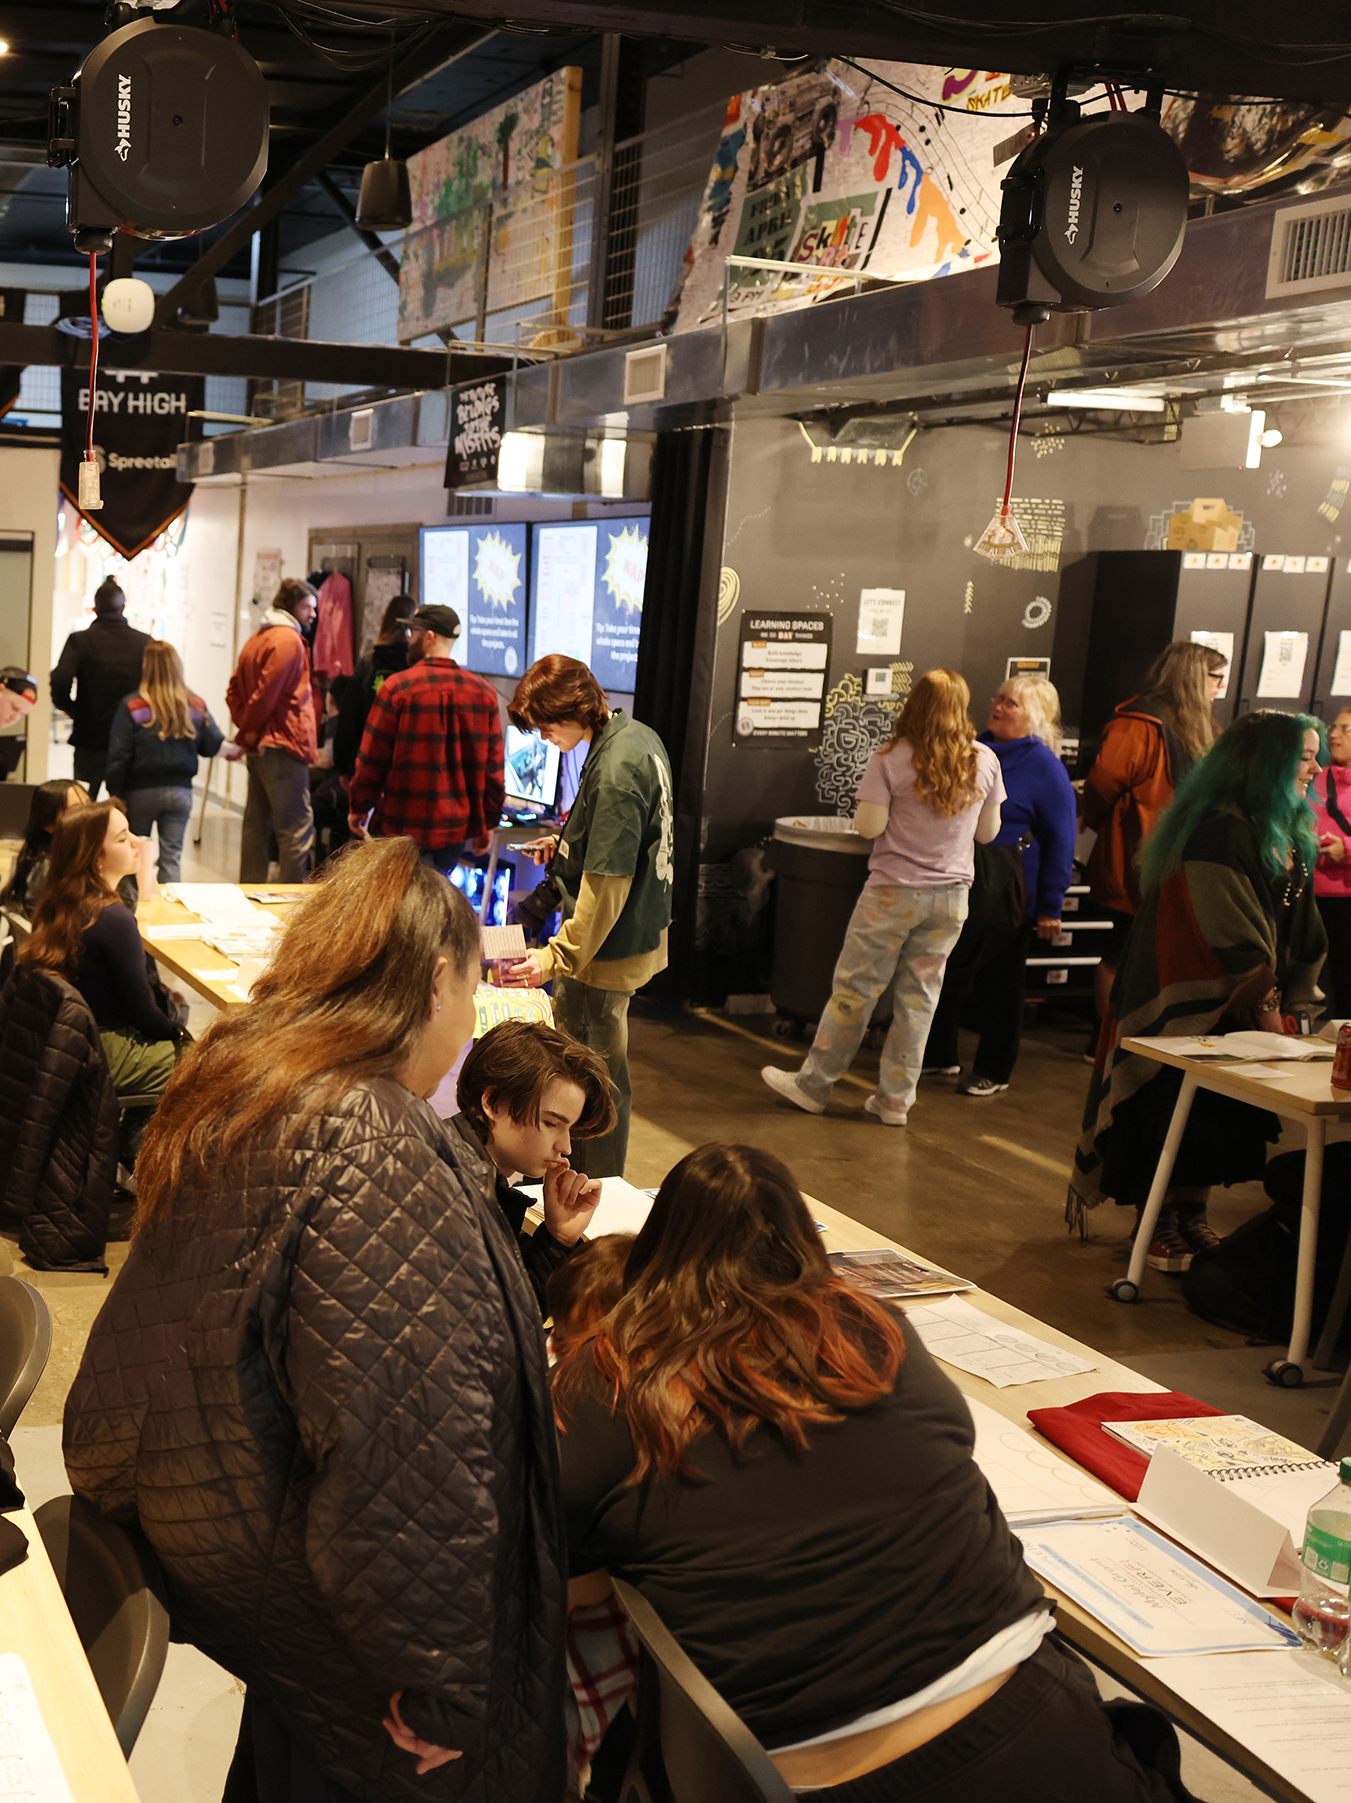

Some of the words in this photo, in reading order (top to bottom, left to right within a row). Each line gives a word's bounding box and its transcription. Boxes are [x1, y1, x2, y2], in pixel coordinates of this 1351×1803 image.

[117, 73, 131, 138] HUSKY
[1067, 165, 1084, 223] HUSKY
[78, 388, 125, 413] BAY
[127, 391, 187, 415] HIGH
[605, 623, 616, 633] Take
[617, 625, 628, 636] your
[628, 624, 640, 635] time
[750, 619, 791, 630] LEARNING
[792, 620, 825, 631] SPACES
[778, 631, 794, 640] BAY
[596, 636, 611, 646] whole
[611, 638, 625, 649] space
[610, 650, 620, 660] the
[620, 651, 638, 663] project
[1119, 1560, 1188, 1605] EVERFI
